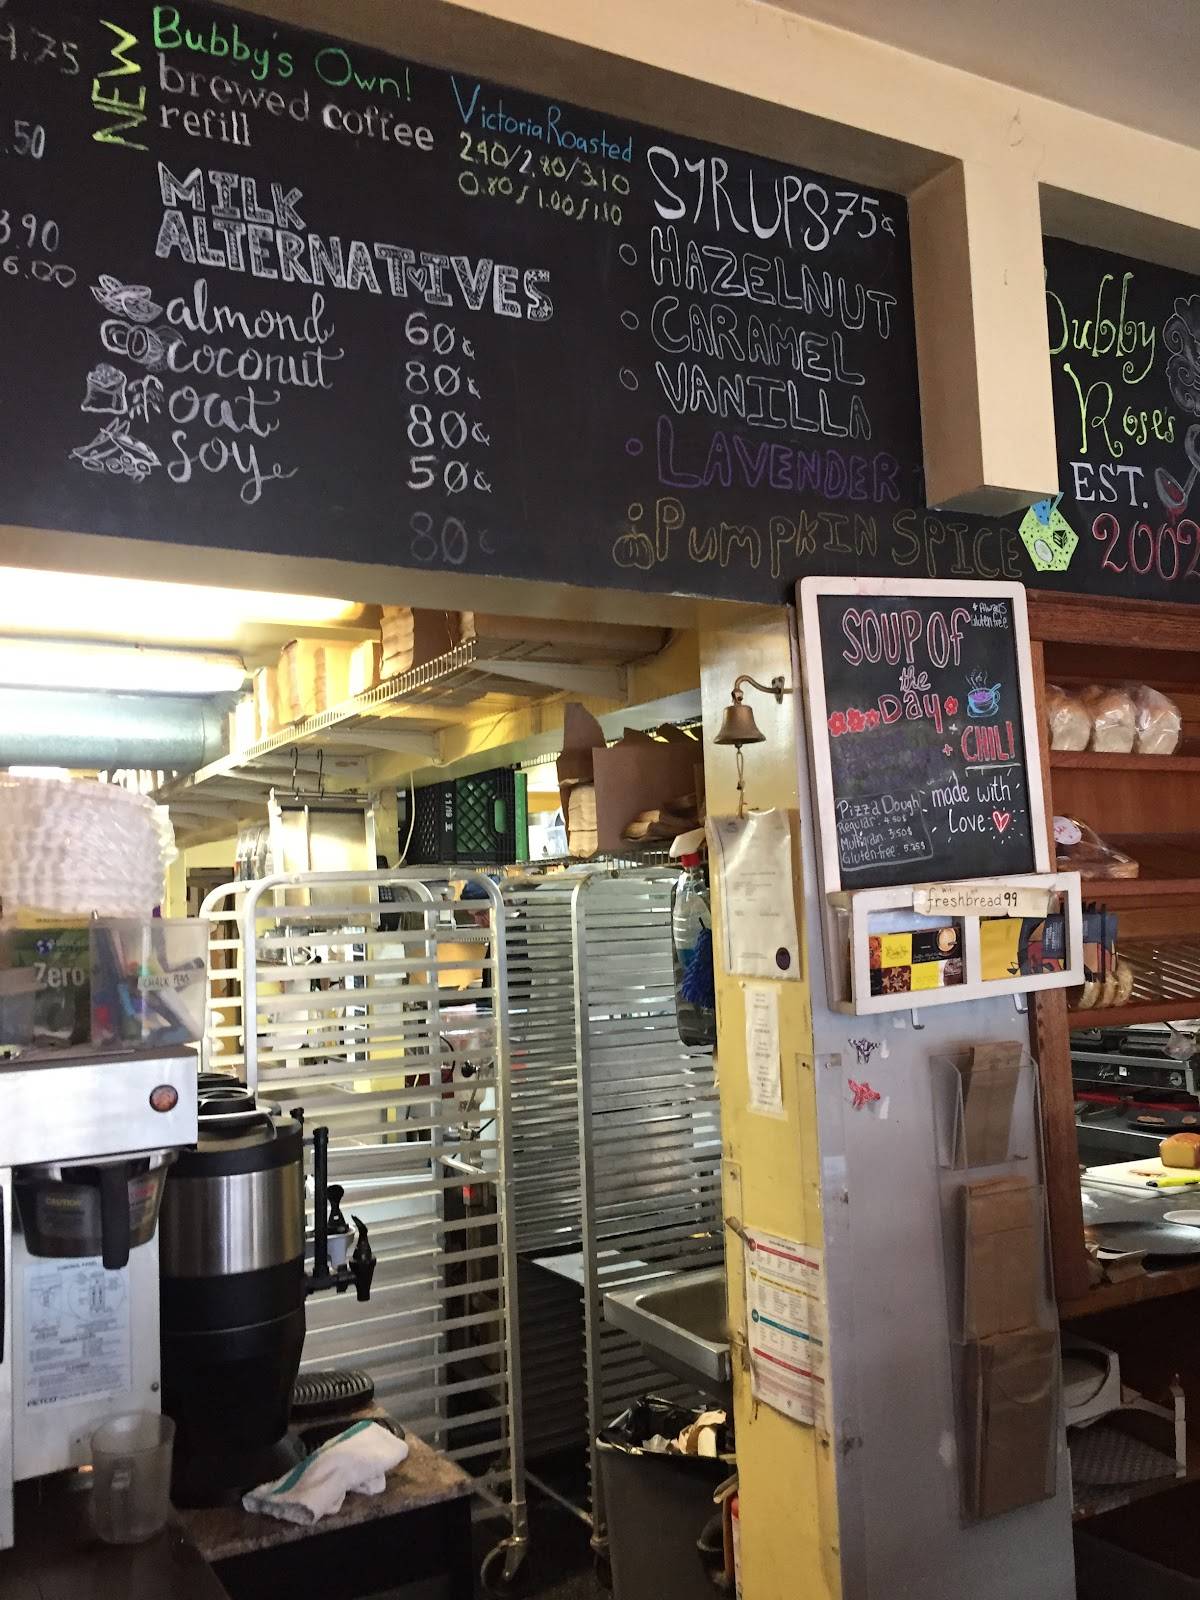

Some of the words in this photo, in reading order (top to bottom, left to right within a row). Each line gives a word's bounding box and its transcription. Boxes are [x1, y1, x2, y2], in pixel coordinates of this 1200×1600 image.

[91, 18, 149, 151] NEW
[152, 5, 294, 81] Bubby's
[314, 47, 413, 101] Own!
[158, 51, 310, 122] brewed
[322, 102, 434, 151] coffee
[159, 104, 252, 146] refill
[450, 74, 543, 140] Victoria
[546, 104, 633, 164] Roasted
[157, 161, 307, 231] MILK
[646, 145, 830, 252] SYRUPS
[2, 255, 77, 289] 6.00
[154, 208, 554, 323] ALTERNATIVES
[650, 224, 899, 340] HAZELNUT
[166, 277, 335, 345] almond
[650, 295, 867, 386] CARAMEL
[166, 337, 345, 390] coconut
[168, 385, 281, 438] oat
[654, 360, 873, 442] VANILLA
[166, 430, 300, 505] soy
[655, 414, 902, 502] LAVENDER
[1069, 461, 1149, 510] EST.
[890, 508, 1023, 580] SPICE
[1091, 511, 1200, 582] 2002
[841, 607, 923, 667] SOUP
[899, 665, 931, 692] the
[961, 720, 1017, 763] CHILI
[836, 799, 881, 819] Pizza
[881, 793, 921, 816] Dough
[931, 770, 970, 808] made
[976, 775, 1012, 802] with
[948, 809, 986, 834] Love
[33, 962, 86, 989] Zero
